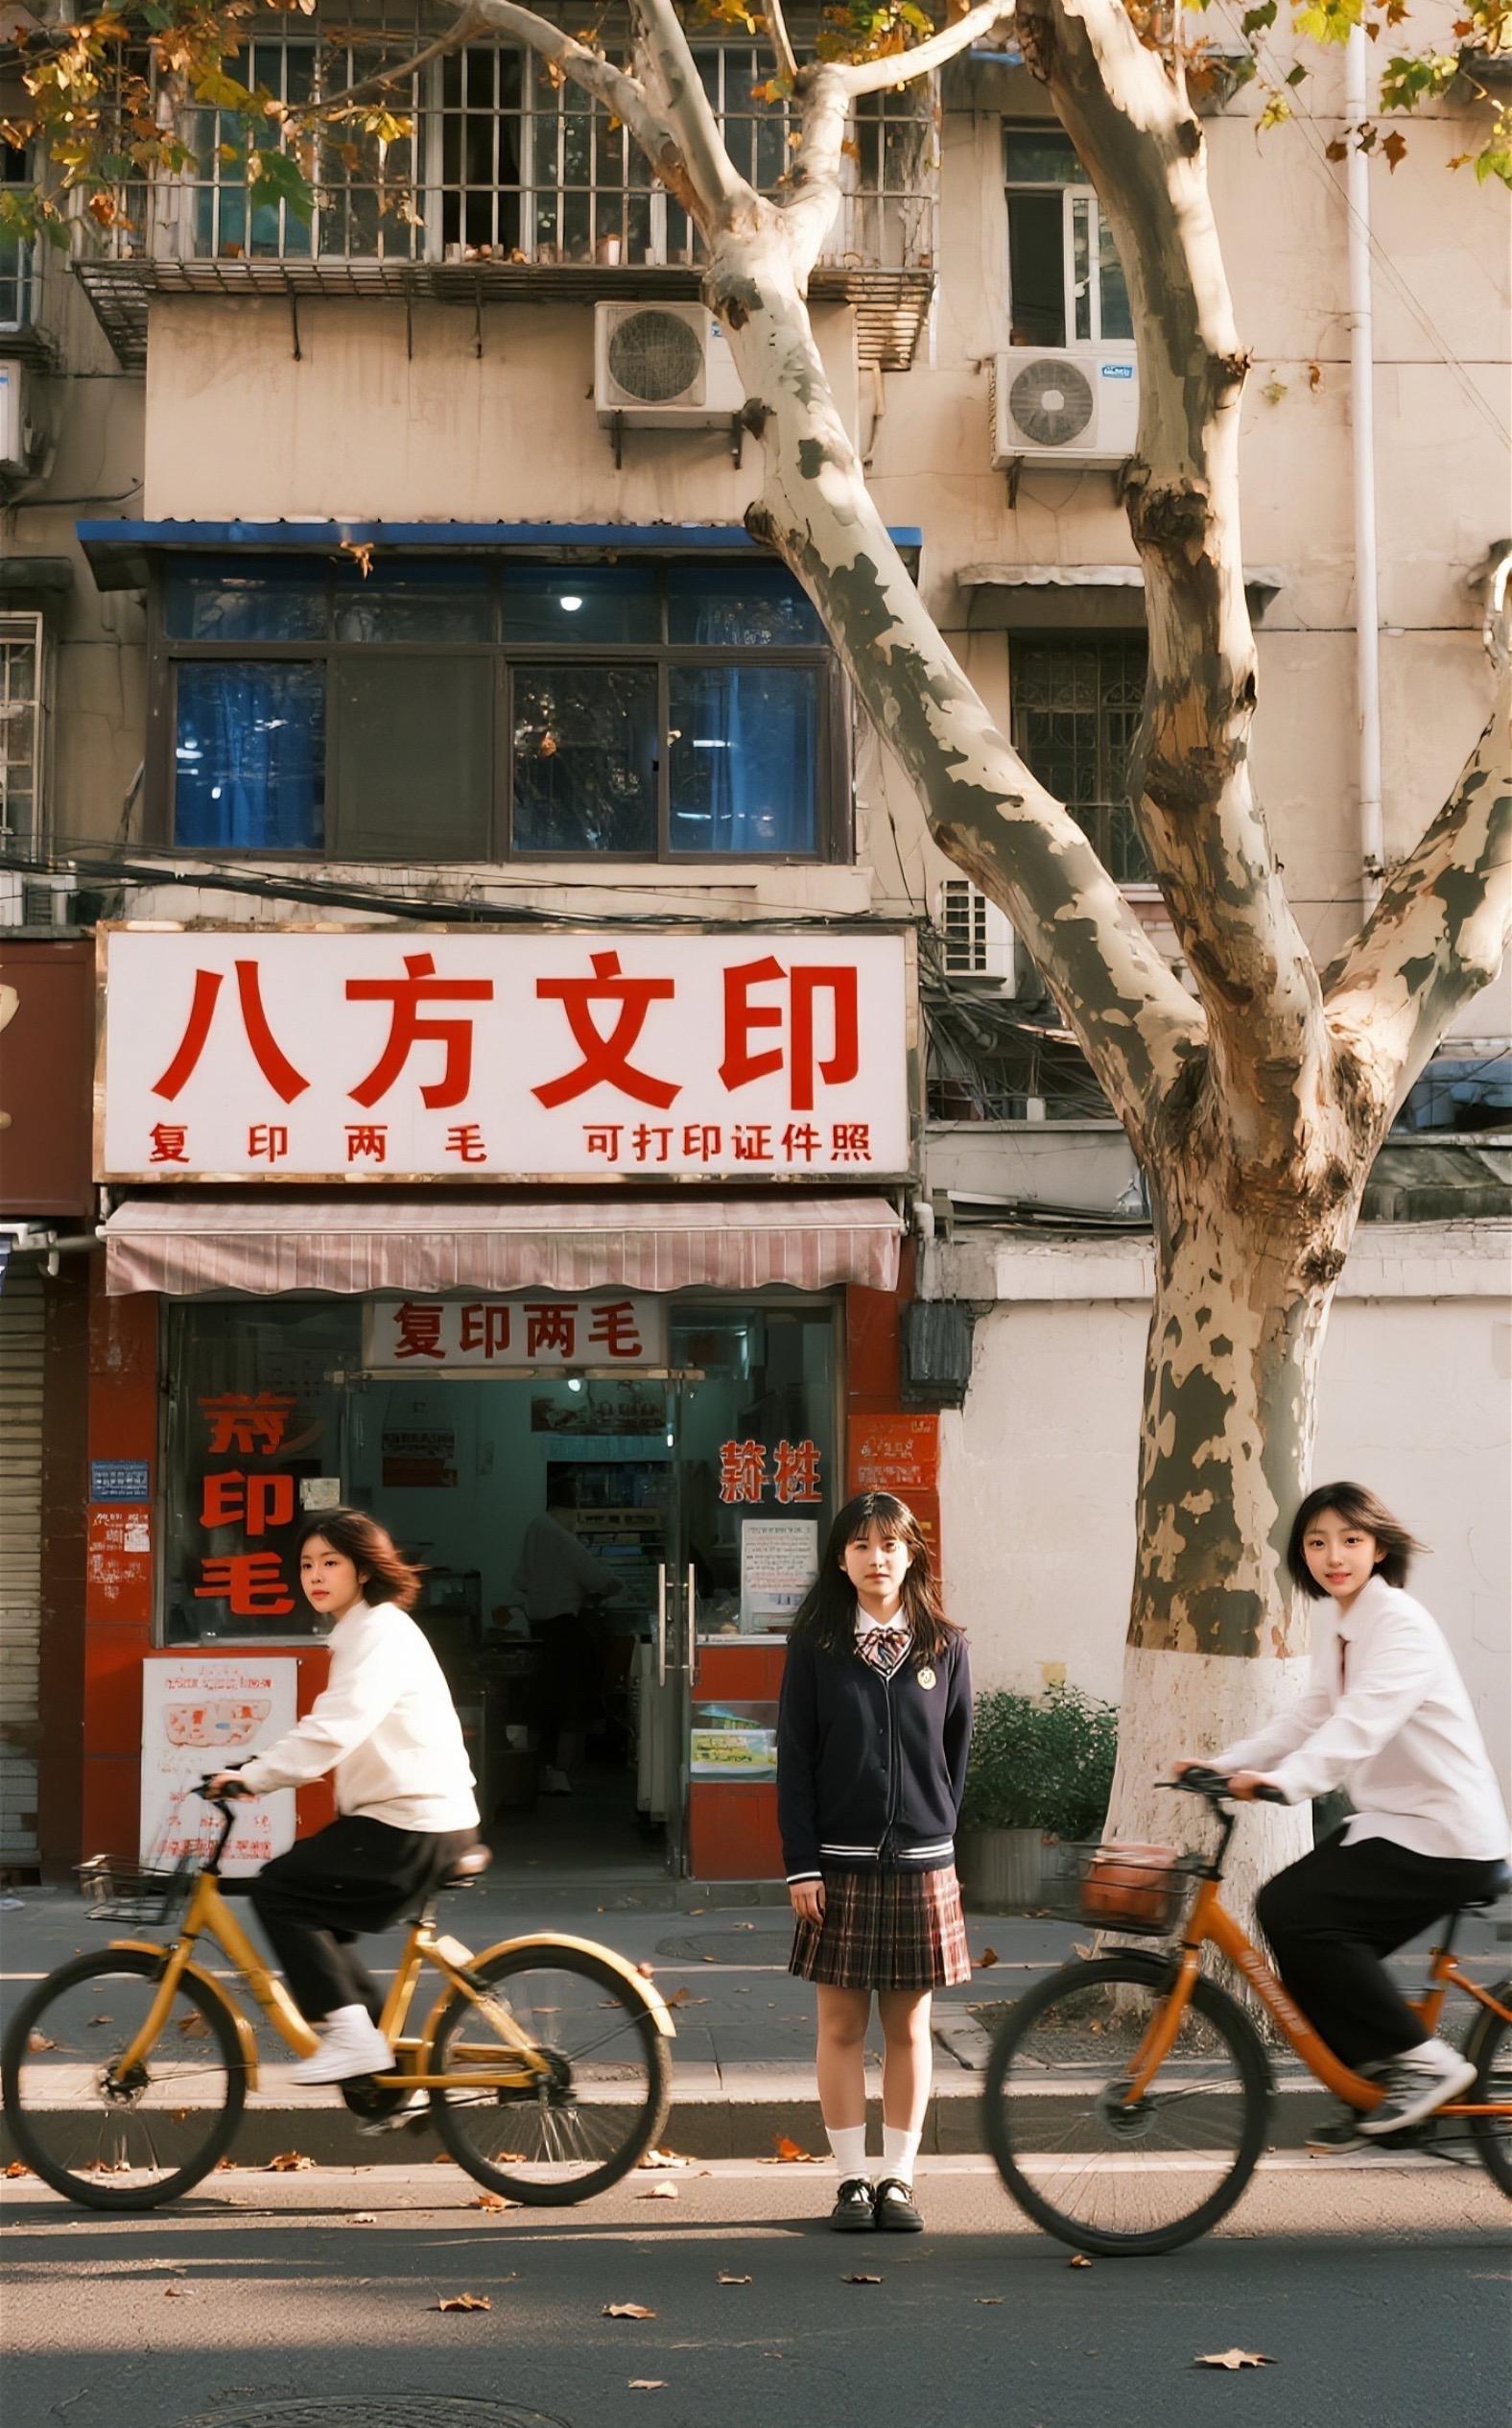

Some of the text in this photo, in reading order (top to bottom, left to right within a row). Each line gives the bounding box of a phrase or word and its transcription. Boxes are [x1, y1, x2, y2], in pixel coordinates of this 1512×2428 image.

[152, 950, 860, 1111] 八方文印
[149, 1122, 872, 1164] 复印两毛 可打印证件照
[394, 1299, 644, 1360] 复印两毛
